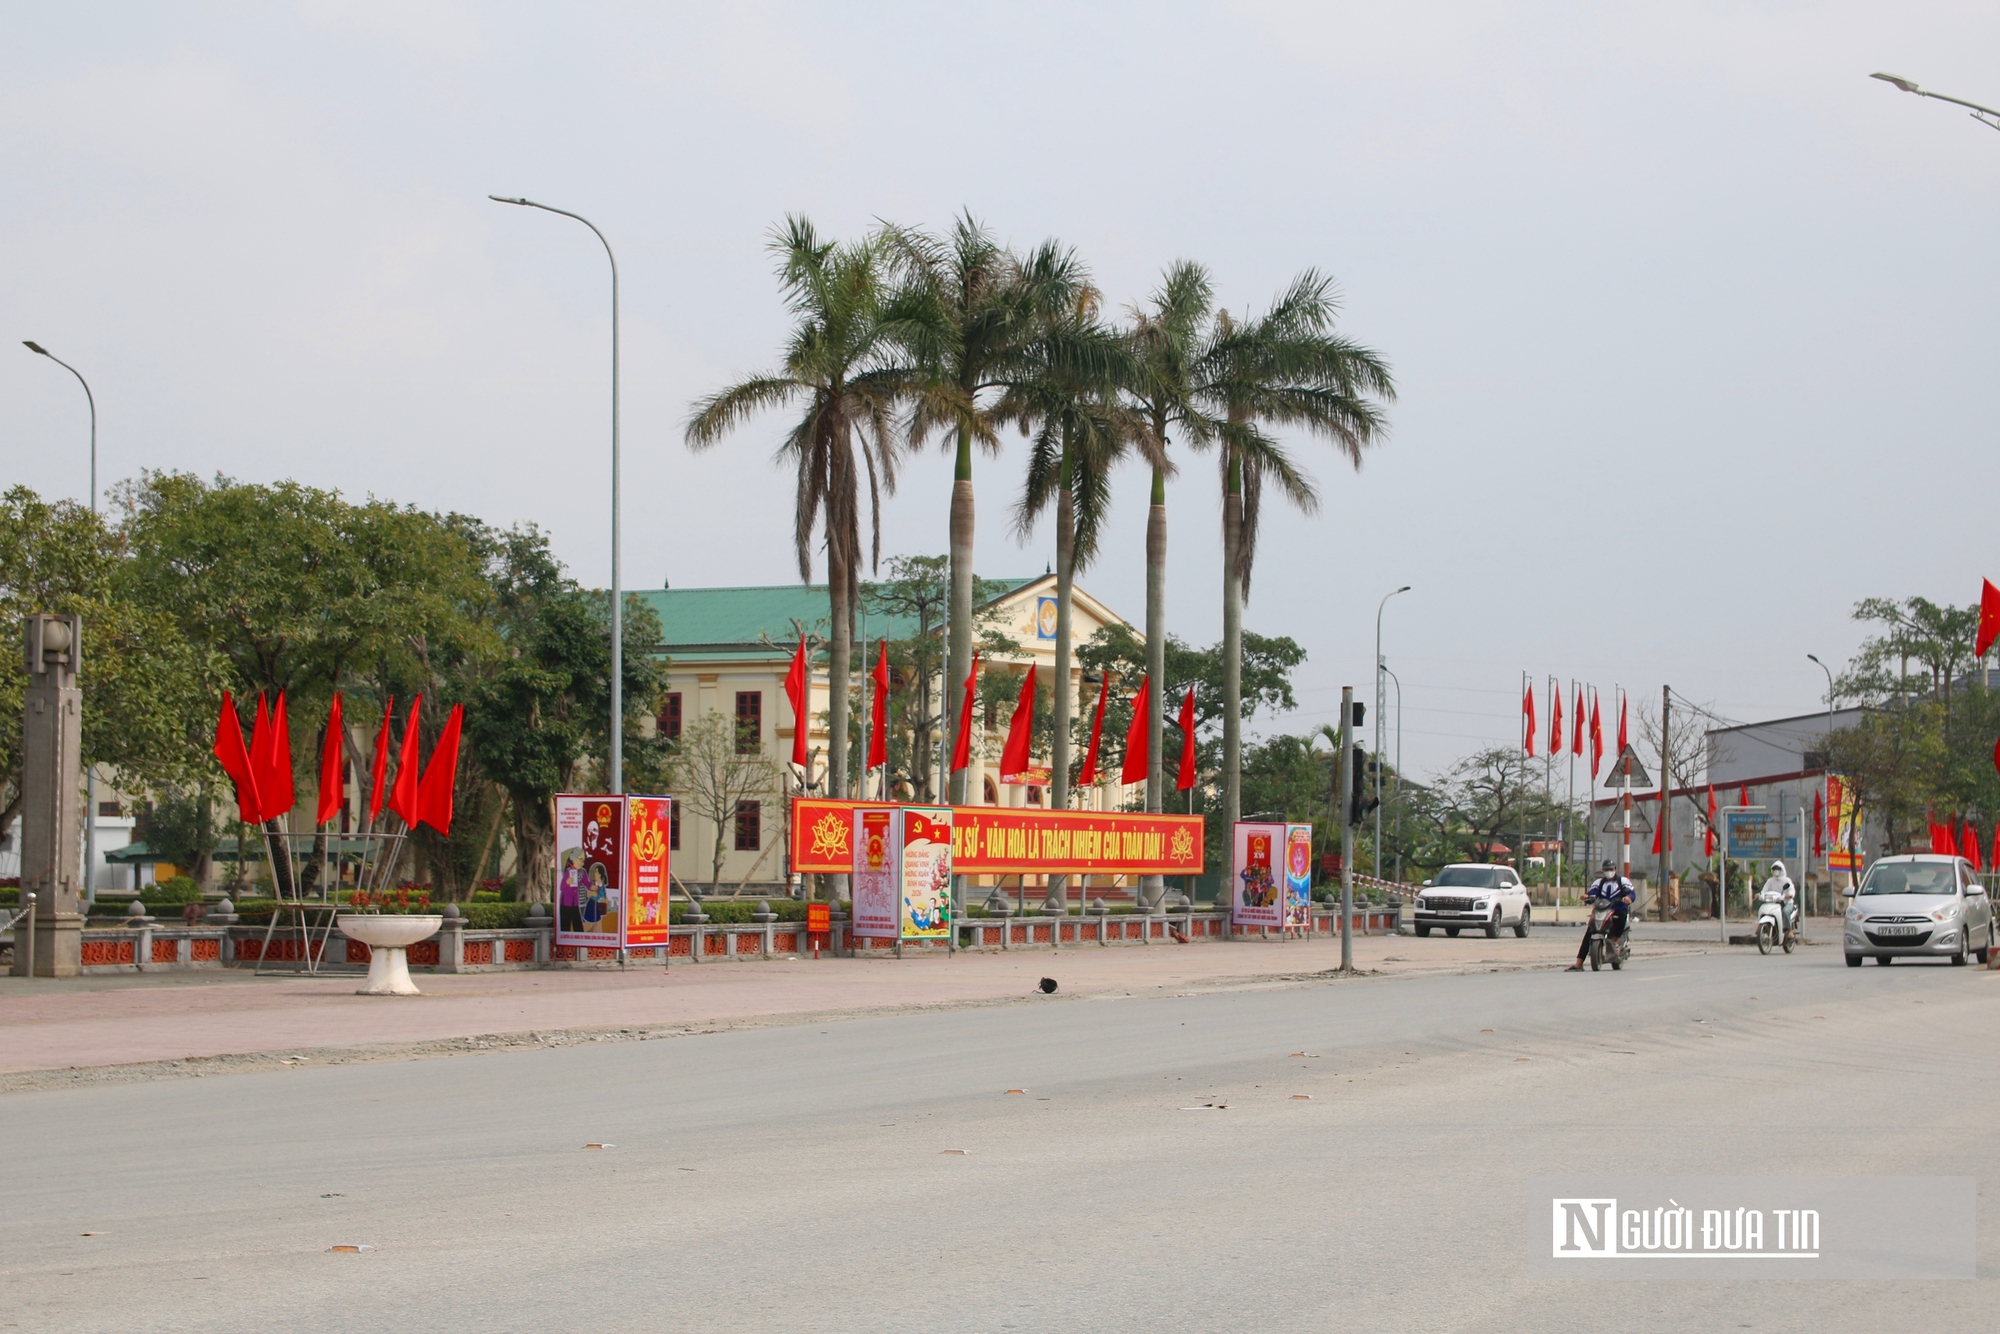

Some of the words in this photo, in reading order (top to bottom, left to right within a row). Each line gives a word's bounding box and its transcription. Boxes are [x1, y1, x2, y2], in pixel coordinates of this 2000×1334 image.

[965, 816, 980, 859] SỬ
[986, 821, 1005, 858] VĂN
[1007, 822, 1026, 859] HOÁ
[1028, 822, 1040, 859] LÀ
[1042, 823, 1071, 859] TRÁCH
[1072, 824, 1102, 867] NHIỆM
[1103, 821, 1120, 861] CỦA
[1122, 825, 1143, 860] TOÀN
[1144, 826, 1161, 861] DÂN
